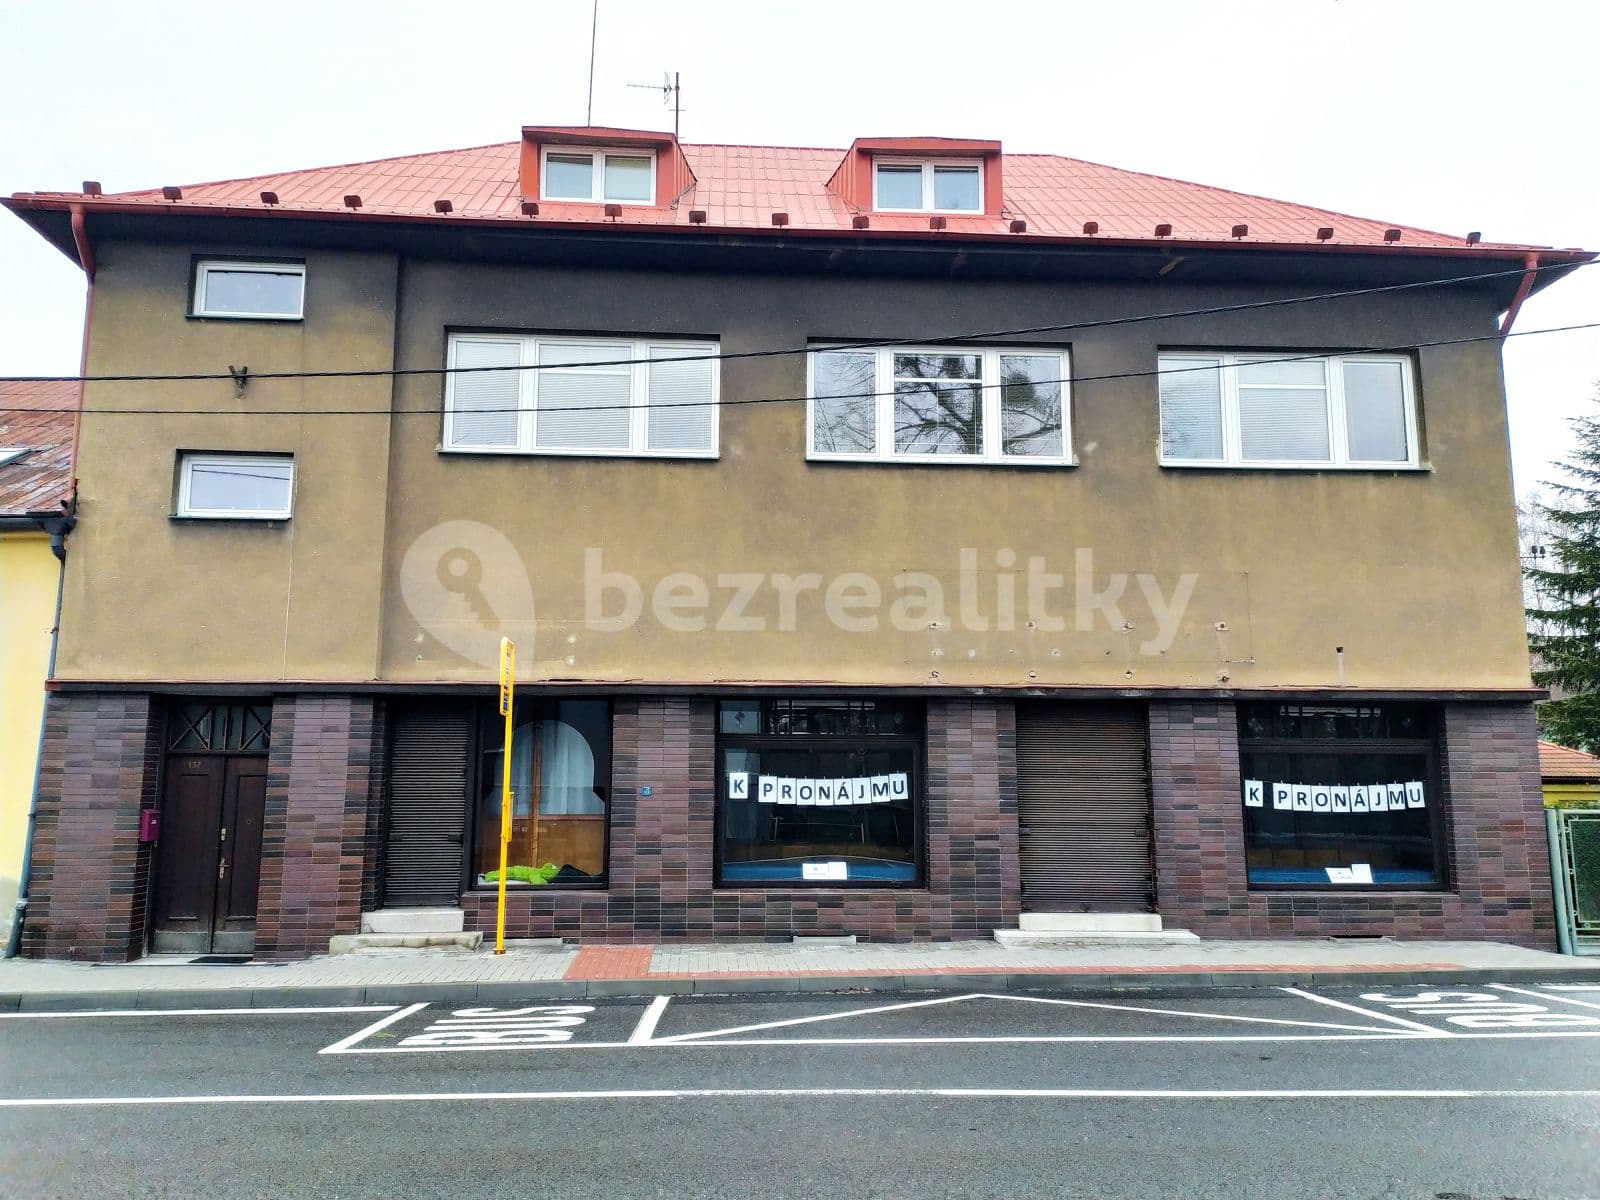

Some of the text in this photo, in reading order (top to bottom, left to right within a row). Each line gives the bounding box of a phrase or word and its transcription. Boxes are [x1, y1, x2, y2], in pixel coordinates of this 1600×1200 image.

[733, 779, 905, 801] K PRONÁJMU
[1249, 787, 1421, 807] K PRONÁJMU
[397, 1005, 596, 1046] BUS
